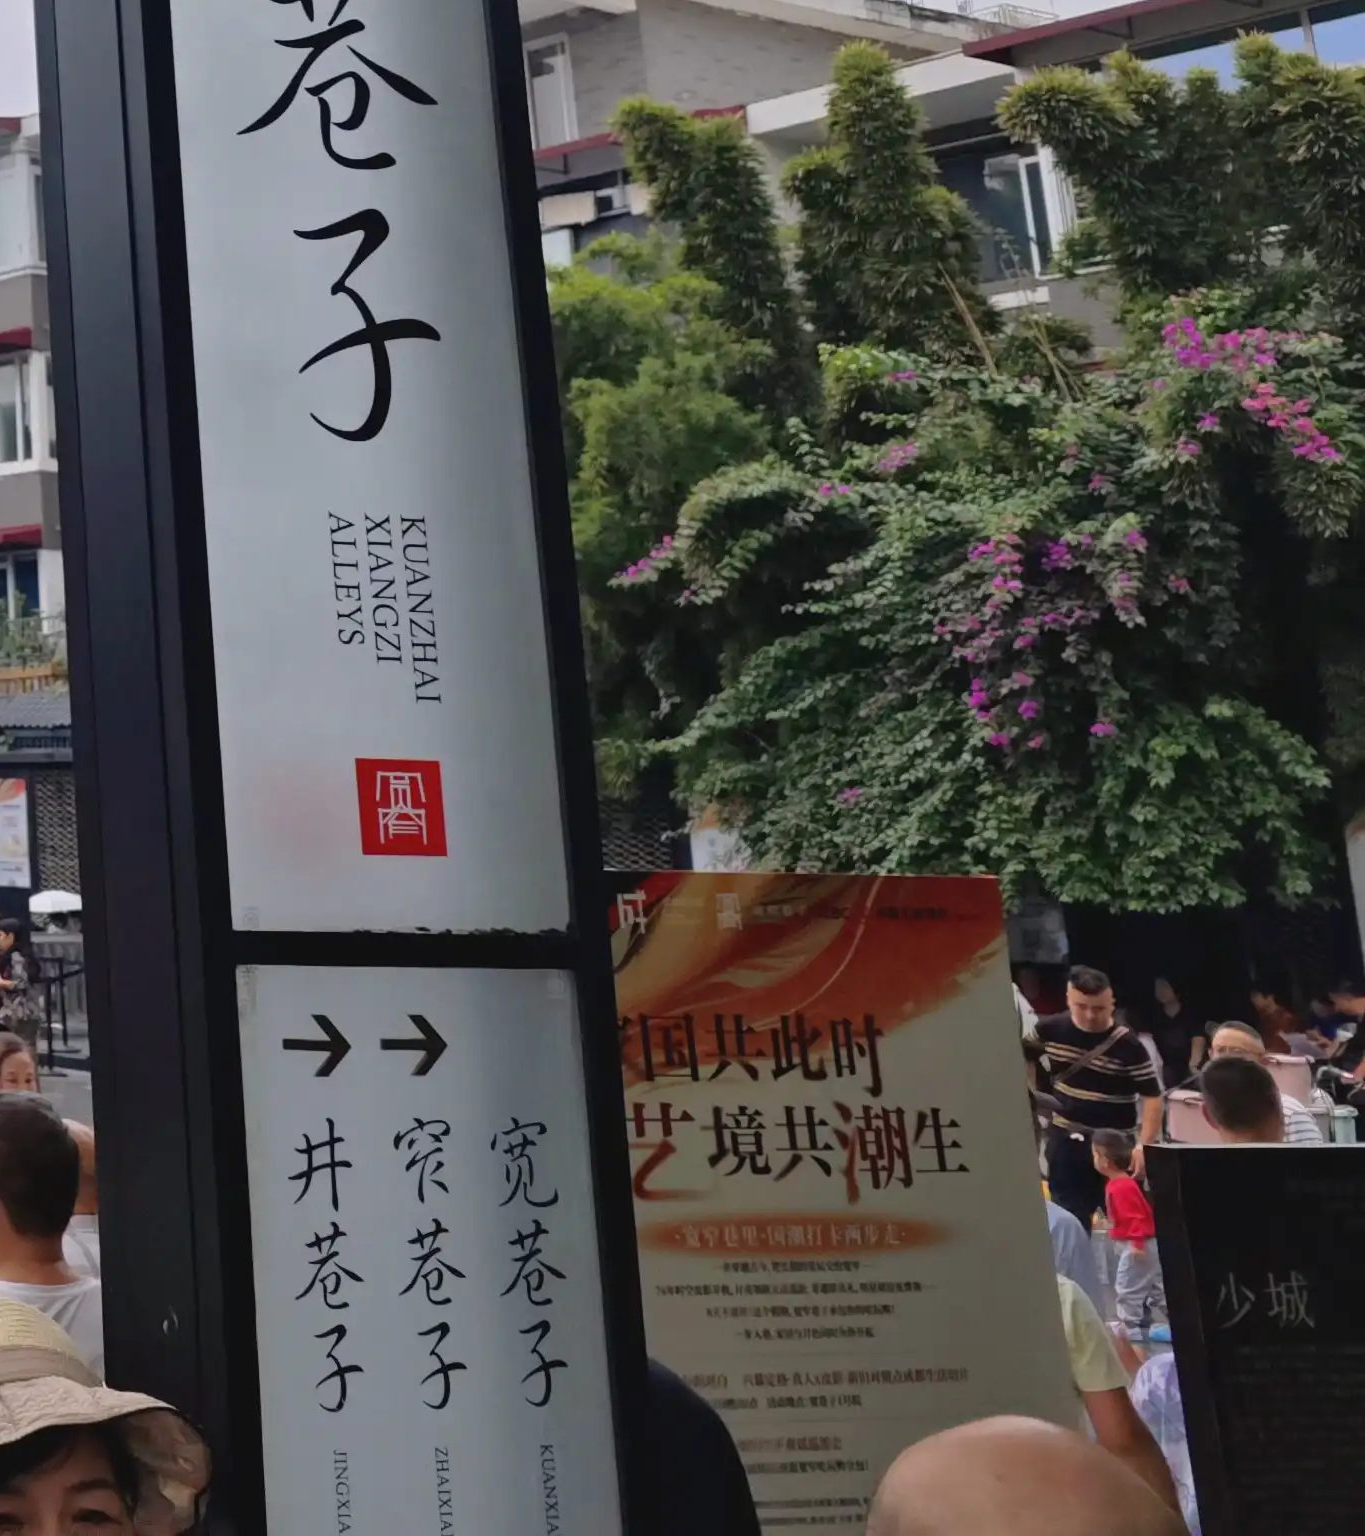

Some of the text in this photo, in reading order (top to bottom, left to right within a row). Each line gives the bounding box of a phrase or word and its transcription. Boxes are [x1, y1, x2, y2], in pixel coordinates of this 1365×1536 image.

[328, 511, 365, 646] ALLEYS
[364, 512, 403, 665] XIANGZI
[400, 513, 443, 704] KUANZHAI
[618, 1012, 885, 1098] 国共此时
[287, 1117, 365, 1413] 井巷子
[393, 1117, 468, 1410] 窄巷子
[490, 1116, 569, 1408] 宽巷子
[1215, 1269, 1317, 1330] 少城
[332, 1448, 352, 1535] JINGXIA
[434, 1446, 454, 1536] ZHAIXIA
